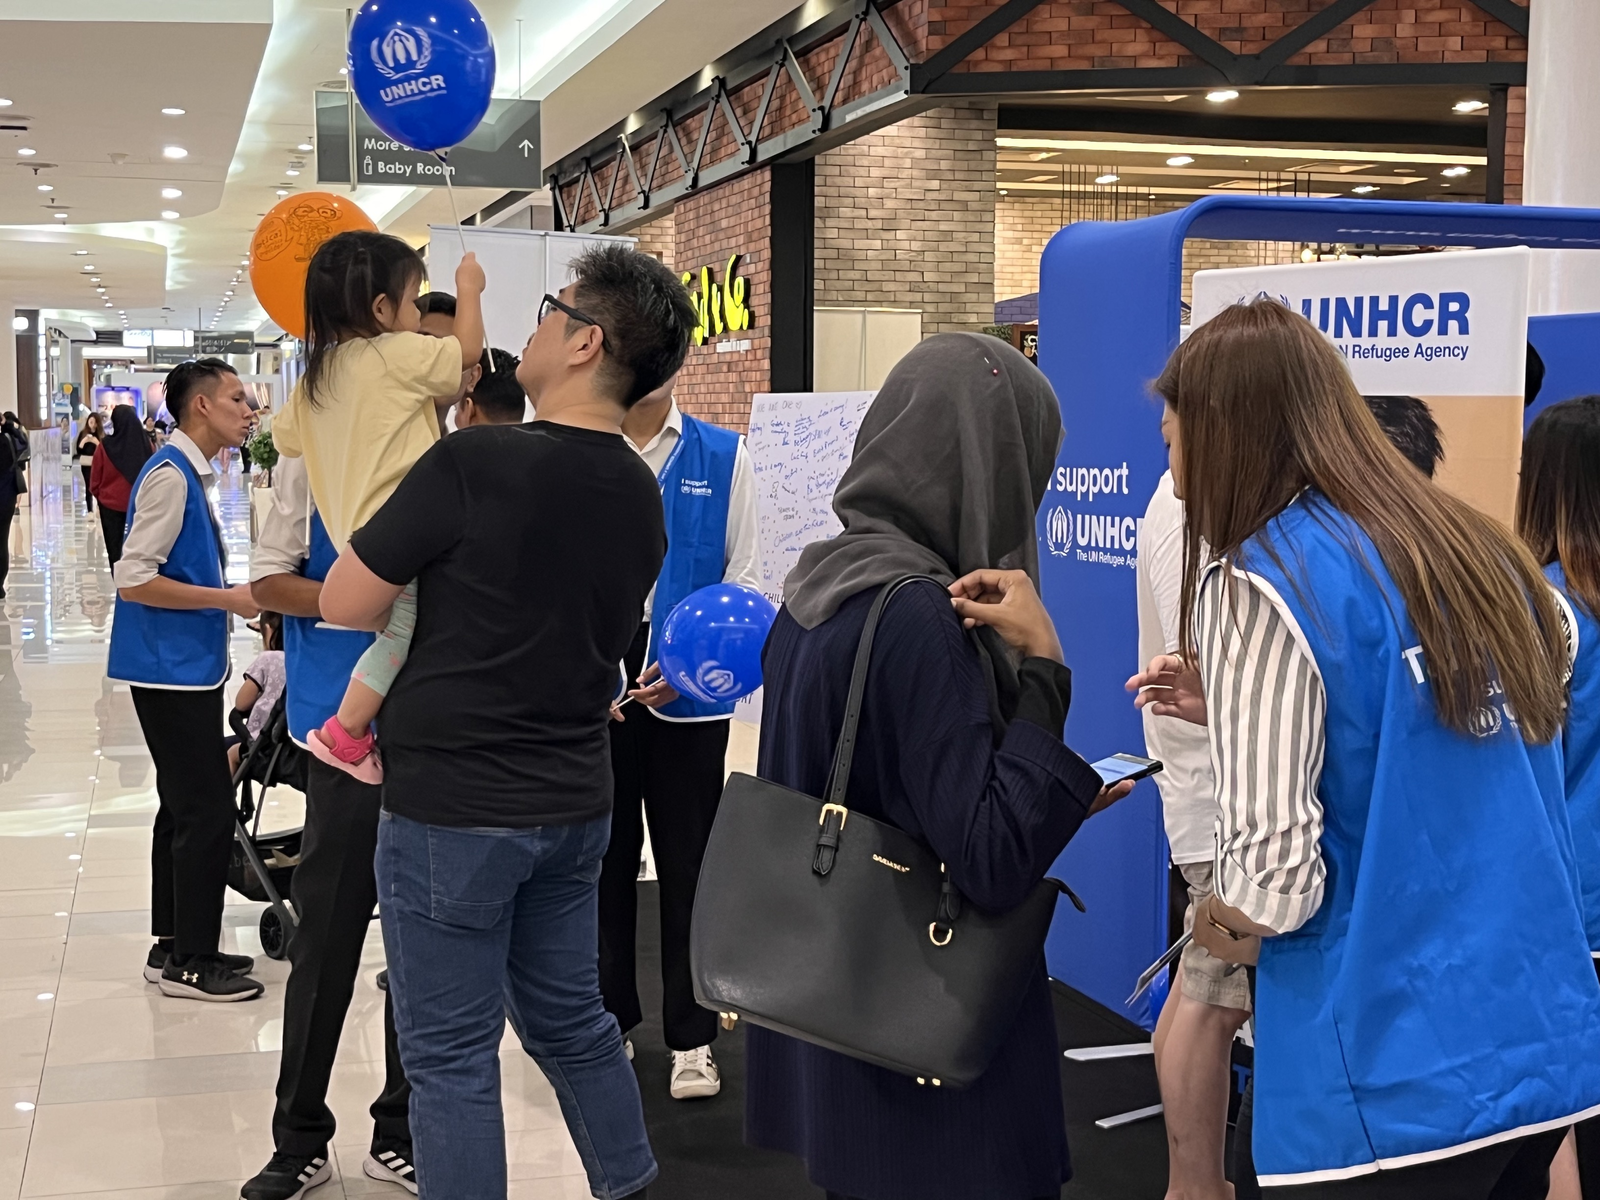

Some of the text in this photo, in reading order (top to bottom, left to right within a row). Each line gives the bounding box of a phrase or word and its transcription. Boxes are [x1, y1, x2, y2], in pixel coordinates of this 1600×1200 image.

[379, 75, 447, 102] UNHCR
[363, 137, 400, 151] More
[377, 161, 456, 177] Baby Room
[1301, 291, 1471, 339] UNHCR
[1351, 343, 1410, 362] Refugee
[1413, 342, 1469, 362] Agency
[1056, 461, 1129, 502] support
[1076, 548, 1088, 562] The
[1088, 550, 1098, 563] UN
[1098, 551, 1125, 567] Refugee
